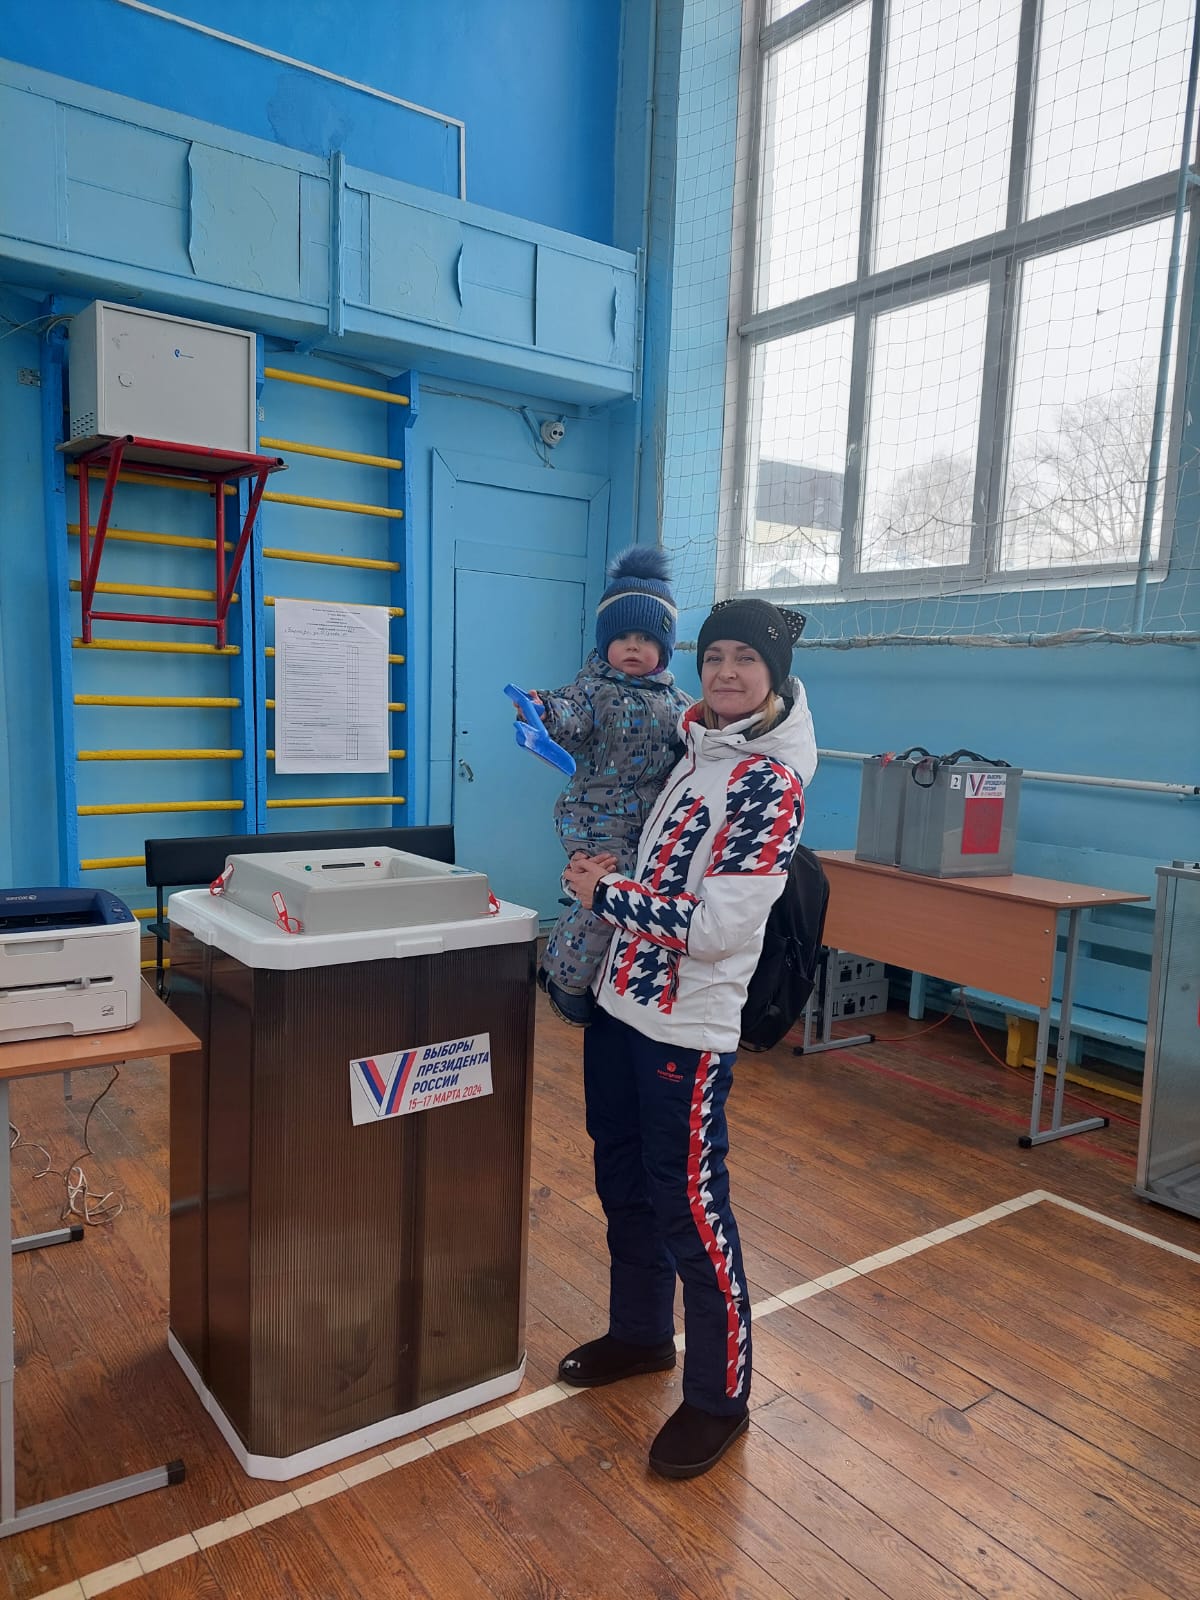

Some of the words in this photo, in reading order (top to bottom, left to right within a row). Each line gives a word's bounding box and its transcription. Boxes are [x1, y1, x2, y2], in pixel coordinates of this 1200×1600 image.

[953, 777, 959, 788] 2
[423, 1039, 475, 1061] ВЫБОРЫ
[416, 1051, 489, 1077] ПРЕЗИДЕНТА
[412, 1073, 459, 1095] РОССИИ
[433, 1089, 460, 1105] МАРТА
[462, 1084, 482, 1098] 2024
